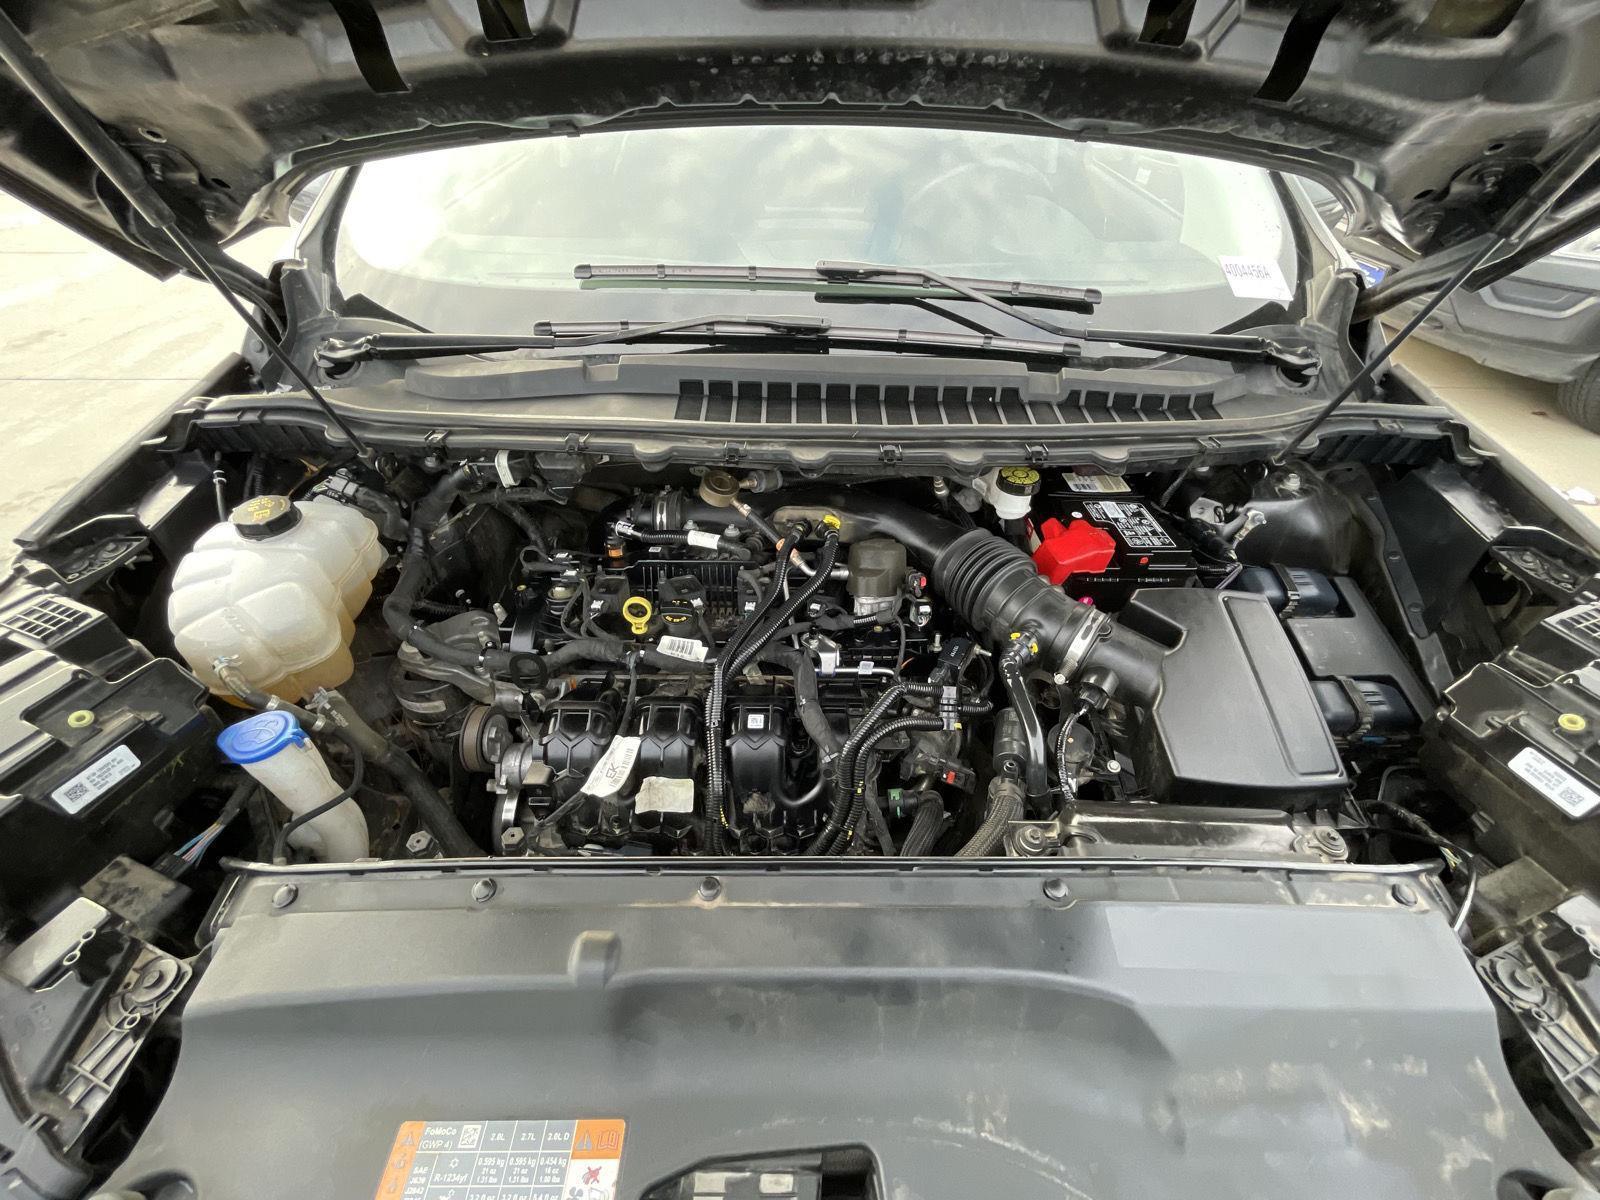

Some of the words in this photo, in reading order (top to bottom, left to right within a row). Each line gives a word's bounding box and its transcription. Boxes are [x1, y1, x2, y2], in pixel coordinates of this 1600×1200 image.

[424, 1127, 457, 1137] FoMoCo
[520, 1132, 536, 1141] 2.7L
[563, 1131, 570, 1141] D
[418, 1139, 444, 1150] (GWP
[433, 1173, 468, 1185] R-1234yf
